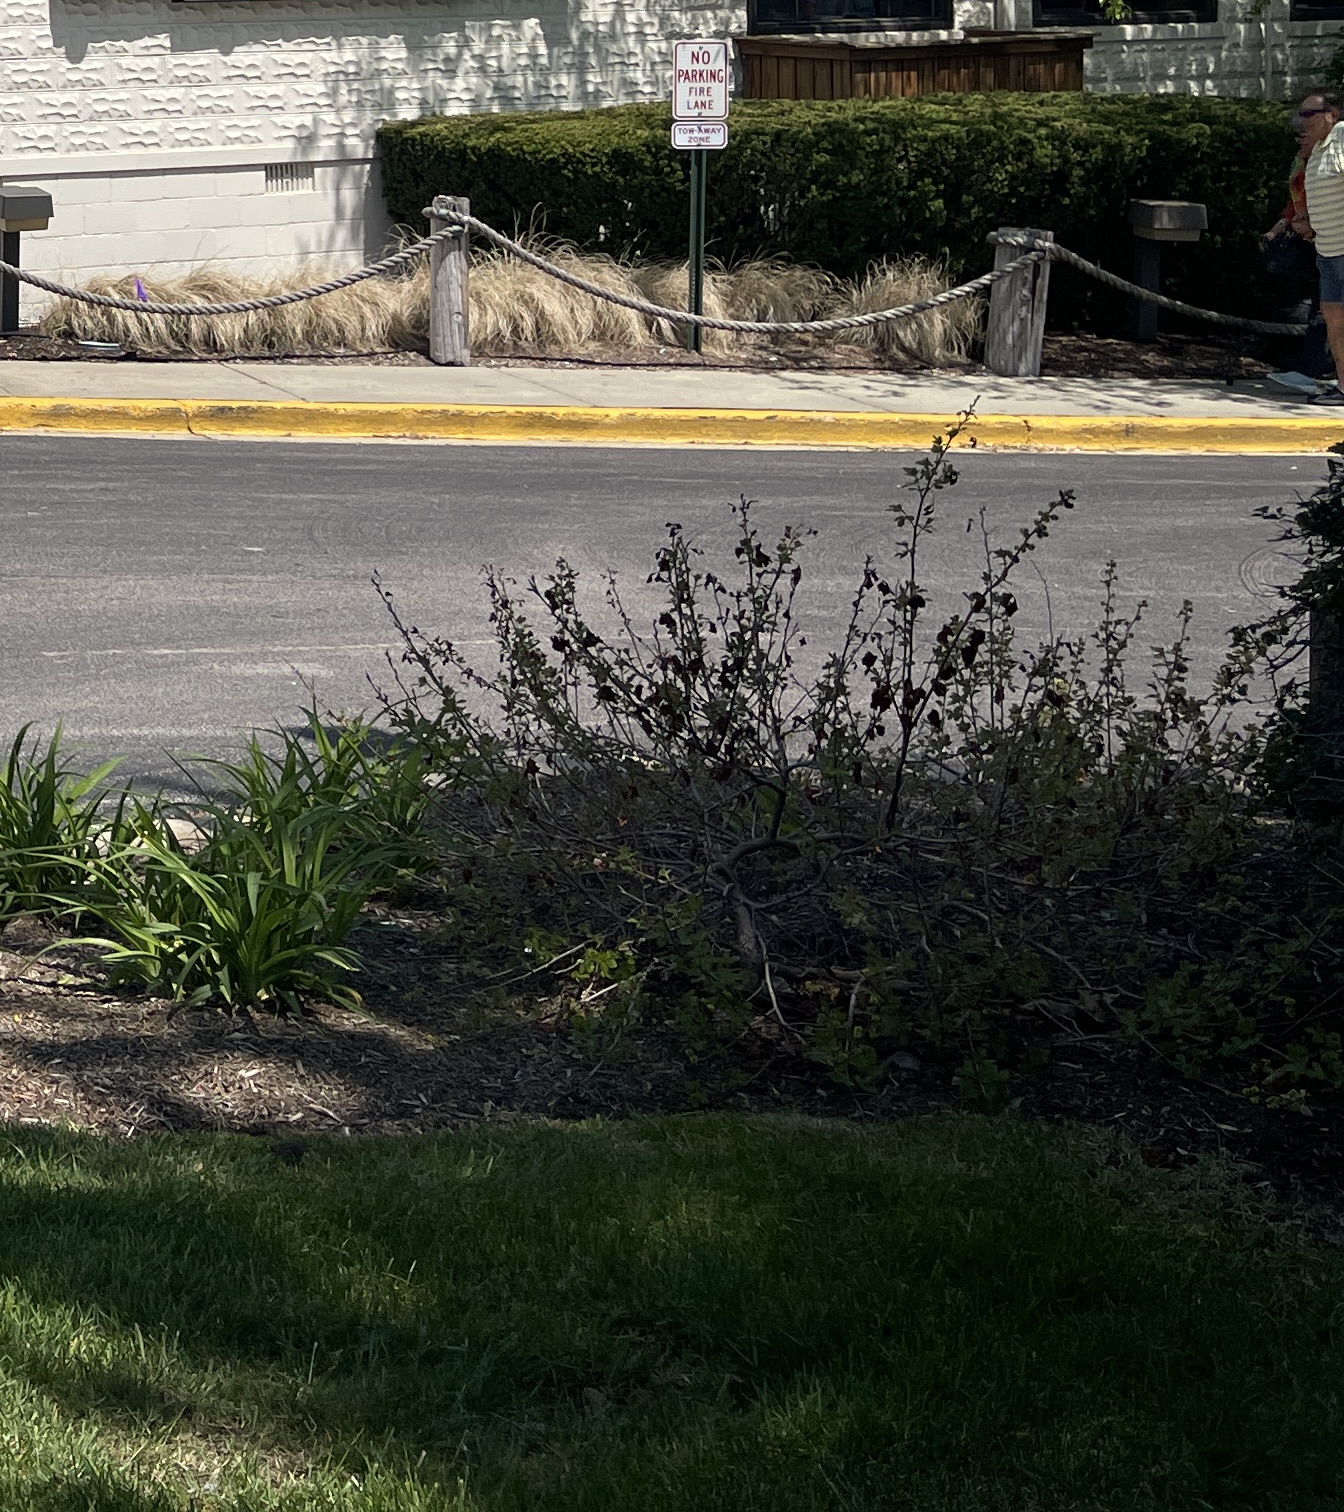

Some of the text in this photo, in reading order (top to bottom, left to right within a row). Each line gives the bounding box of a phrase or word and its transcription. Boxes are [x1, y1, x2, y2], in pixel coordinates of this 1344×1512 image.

[691, 51, 710, 64] NO
[678, 69, 723, 83] PARKING
[689, 87, 712, 96] FIRE
[687, 100, 713, 109] LANE
[687, 136, 711, 144] ZONE
